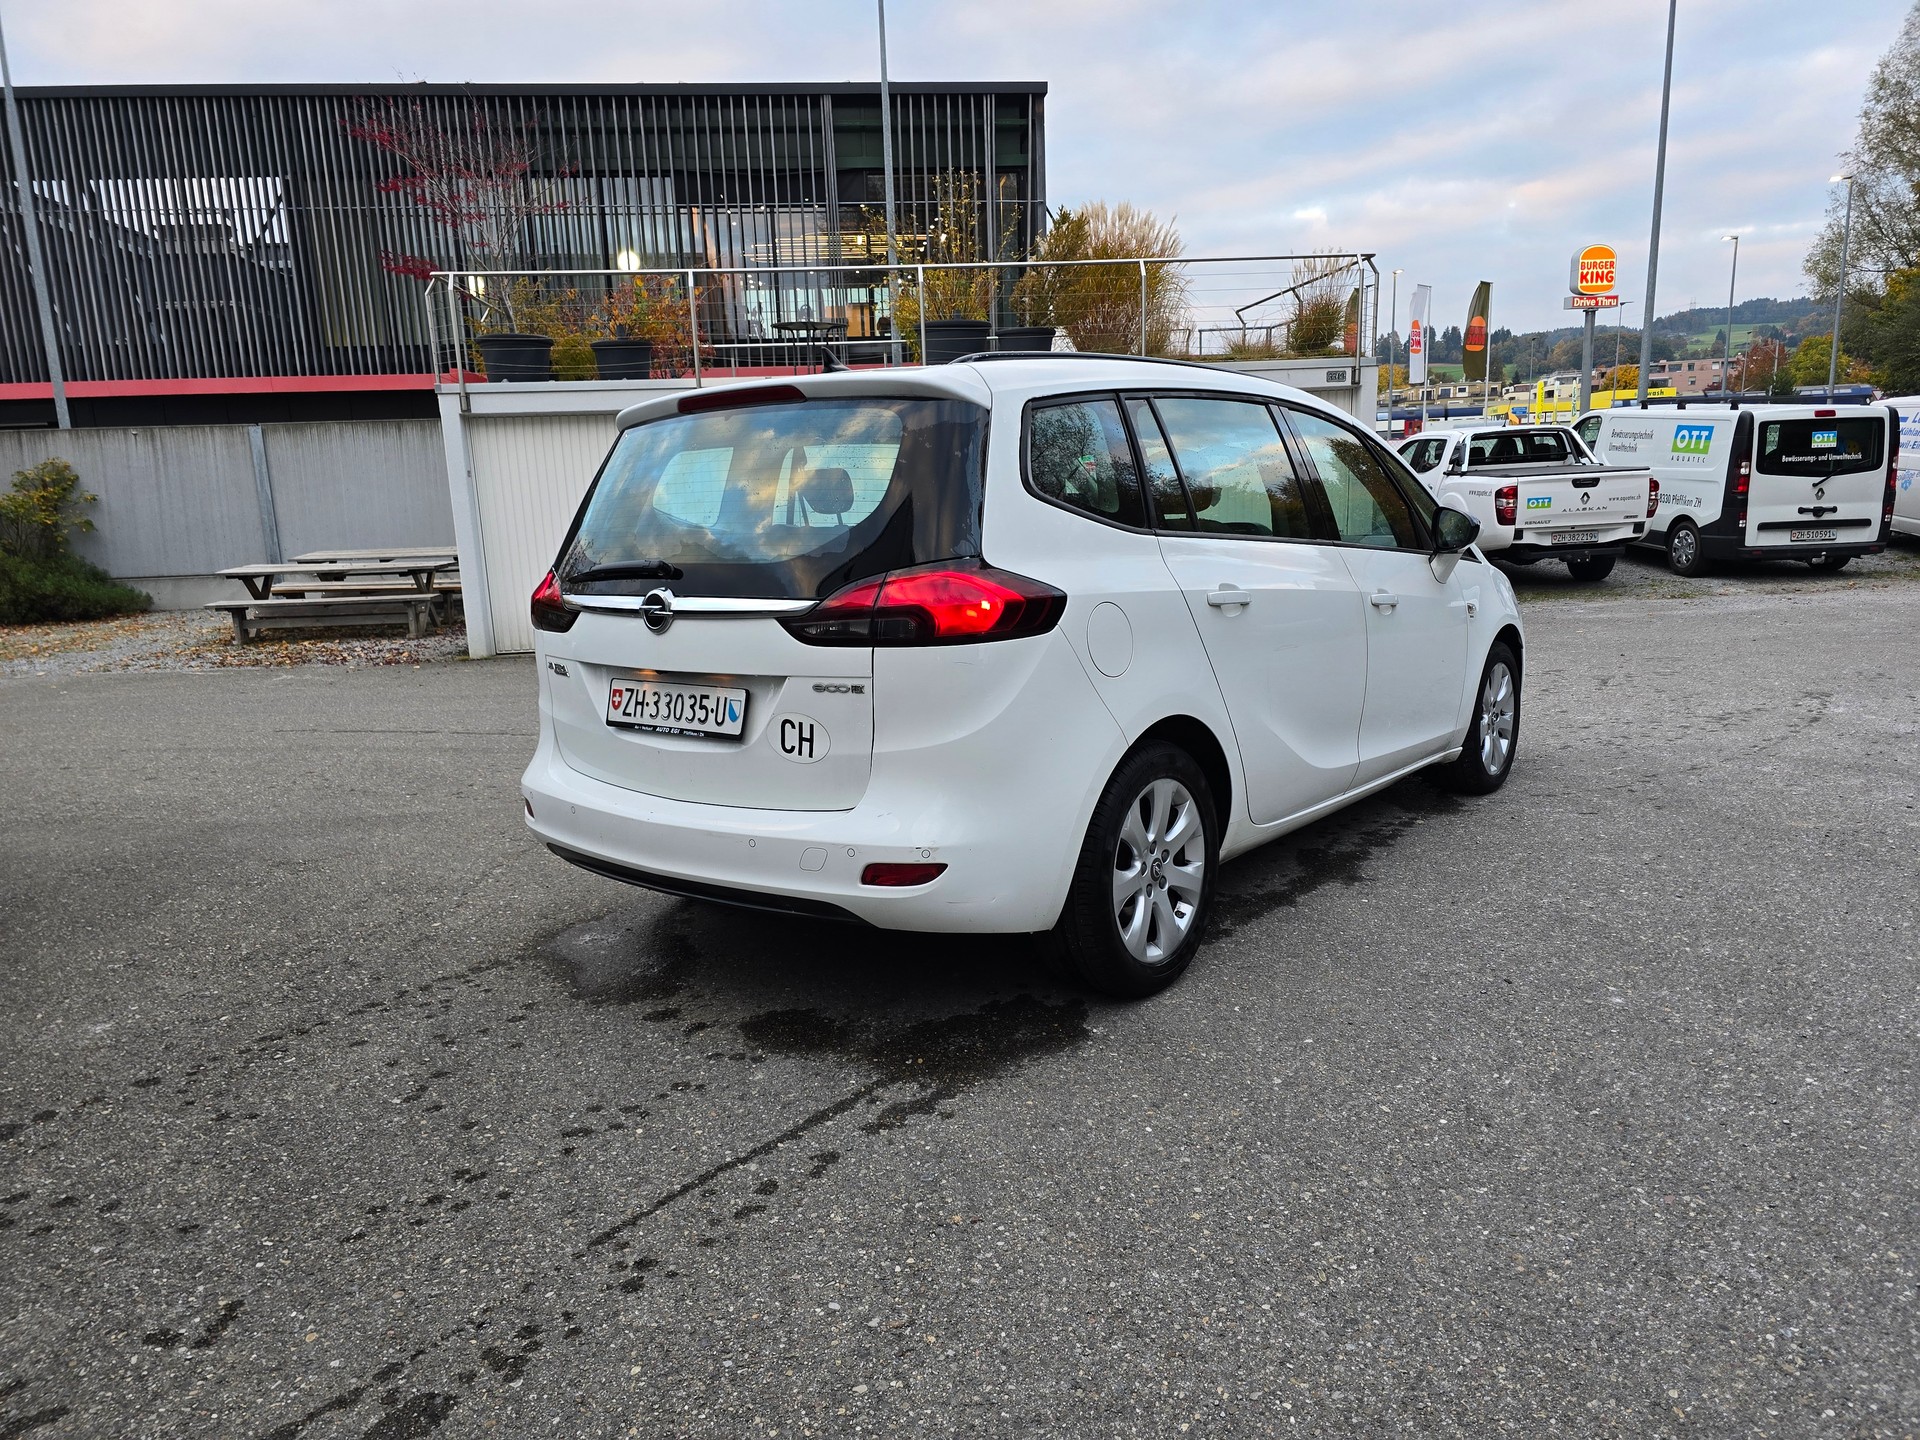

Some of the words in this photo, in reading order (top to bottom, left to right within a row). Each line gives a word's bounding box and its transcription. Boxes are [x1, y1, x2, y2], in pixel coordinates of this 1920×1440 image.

[1580, 261, 1615, 270] BURGER
[1580, 270, 1614, 284] KING
[1573, 297, 1596, 307] Drive
[1597, 297, 1617, 306] Thru
[1676, 429, 1710, 449] OTT
[1814, 433, 1835, 442] OTT
[1818, 453, 1828, 461] und
[1828, 452, 1862, 461] Umwelttechnik
[1528, 498, 1550, 508] OTT
[1693, 497, 1702, 508] ZH
[1561, 505, 1608, 513] ALASKAN
[780, 718, 815, 759] CH
